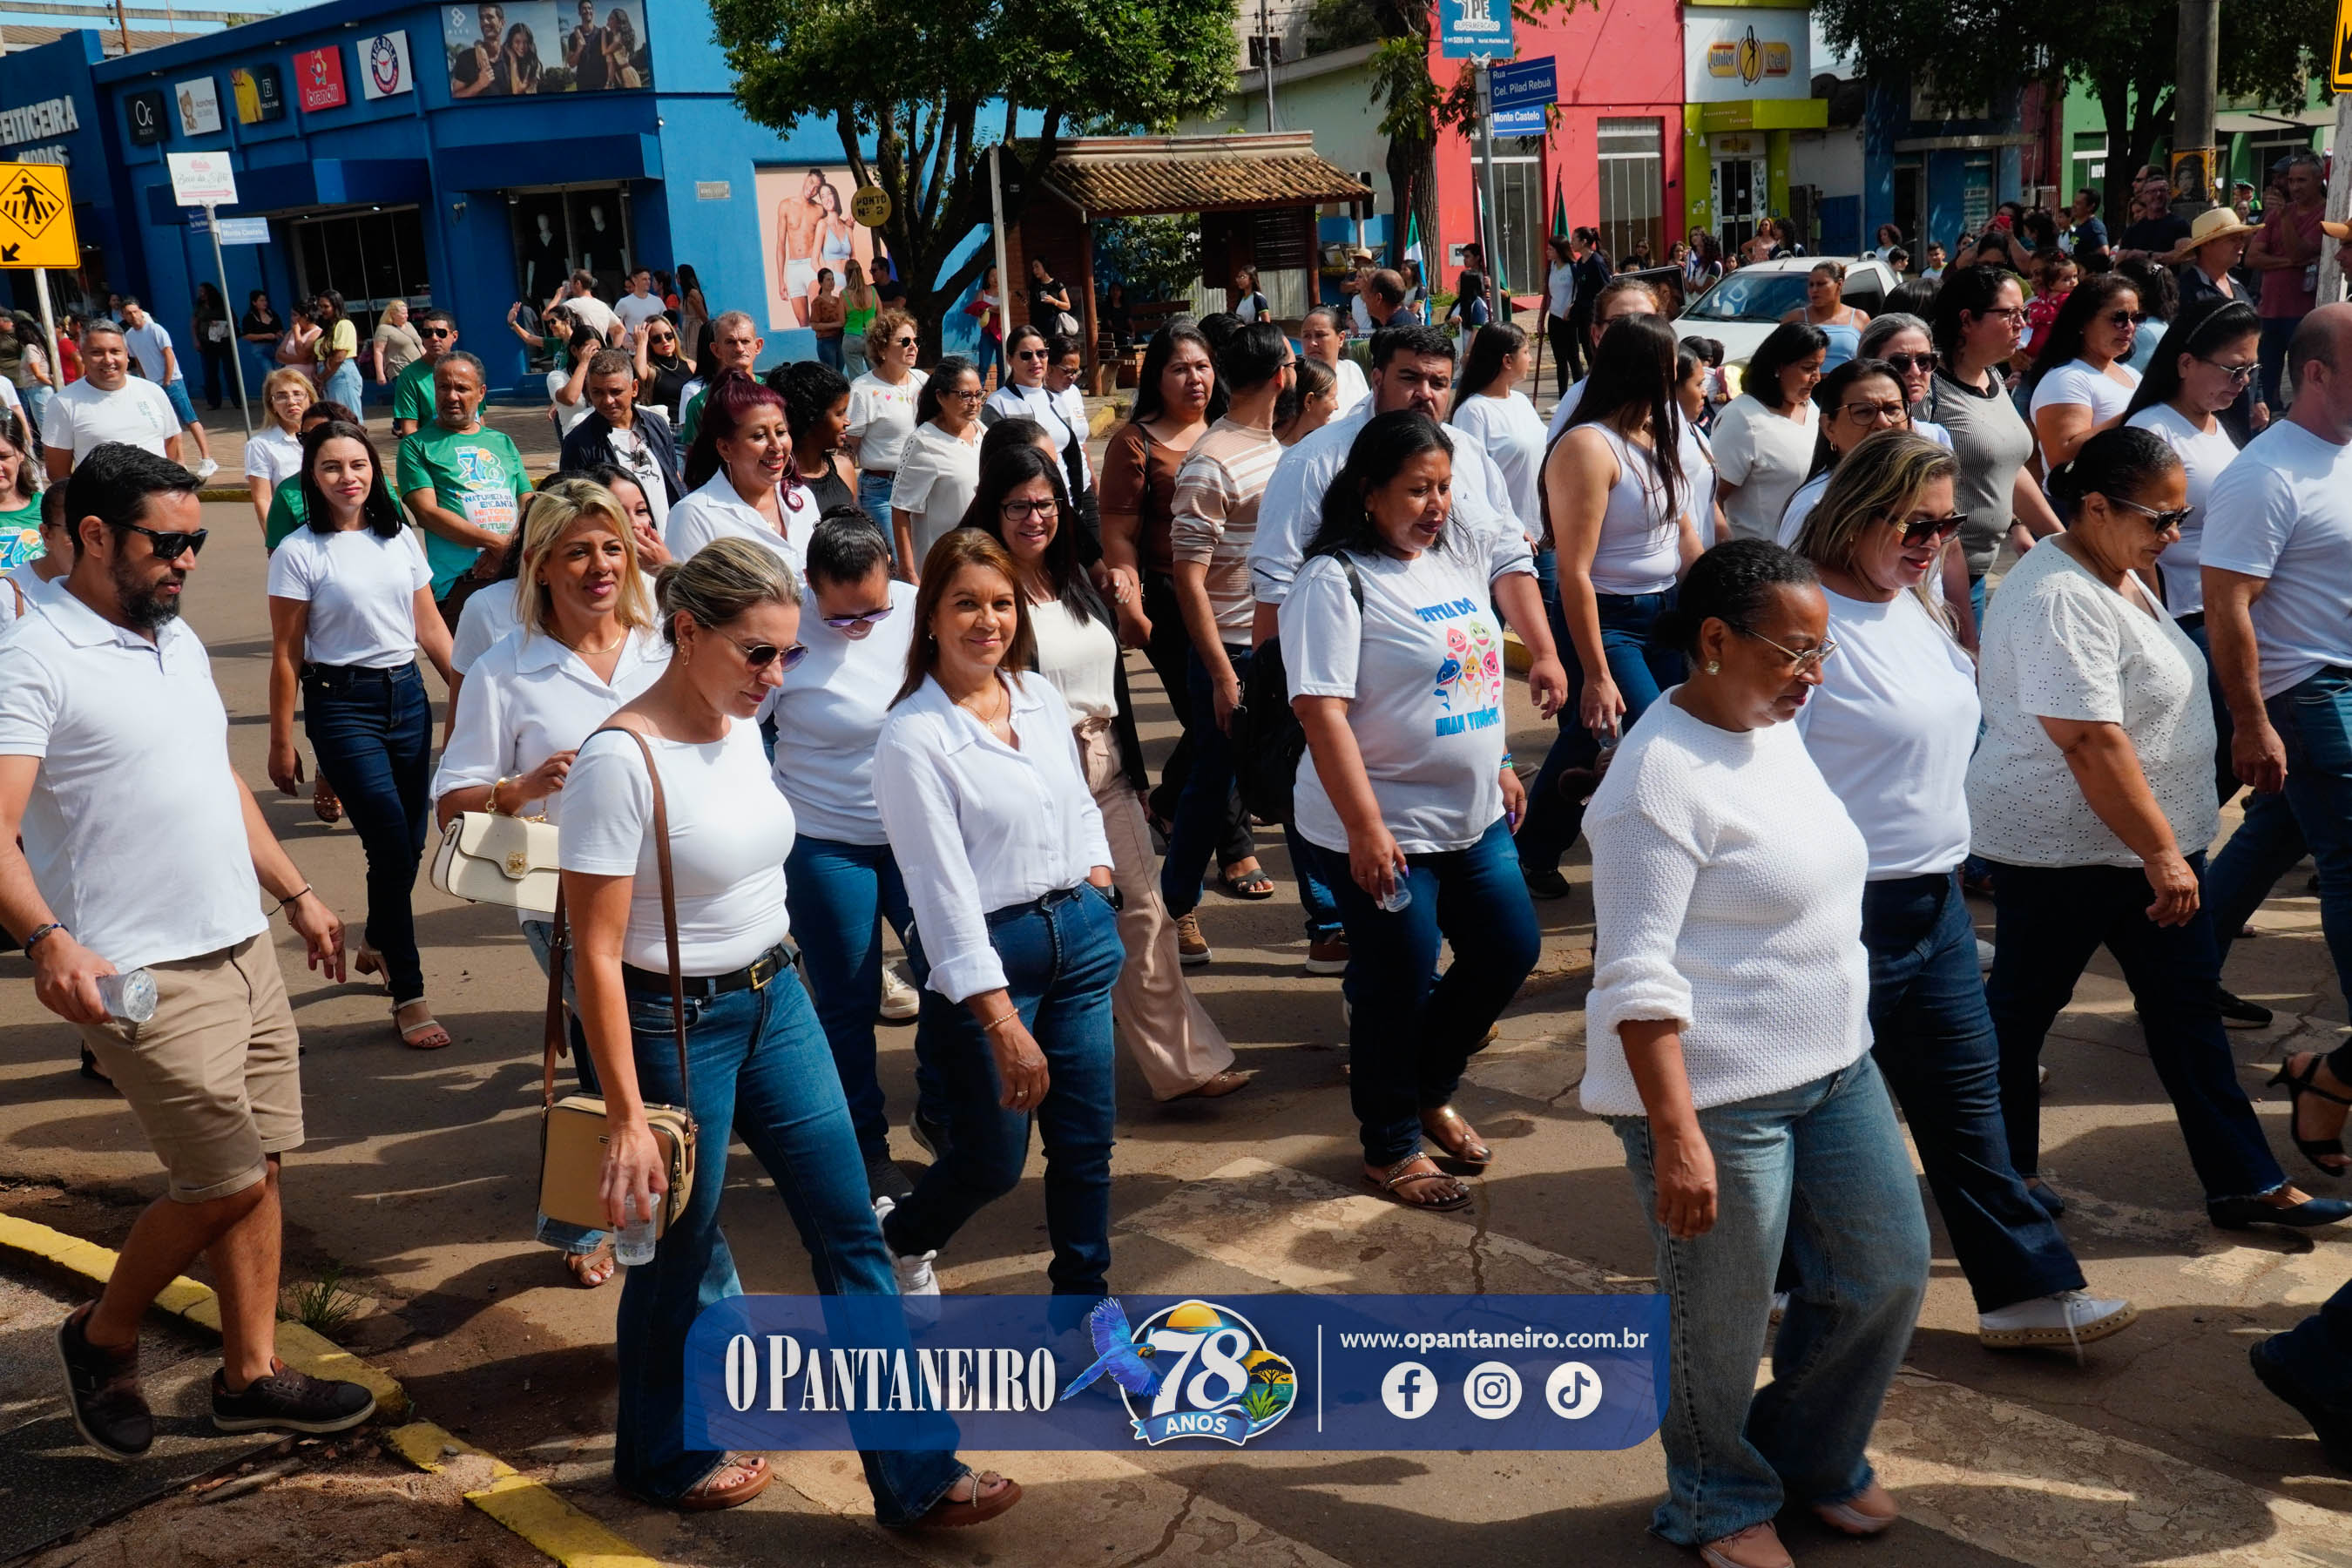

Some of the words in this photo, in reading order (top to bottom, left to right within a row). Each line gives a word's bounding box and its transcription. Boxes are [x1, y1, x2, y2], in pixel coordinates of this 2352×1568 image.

[1708, 52, 1734, 69] Junior
[1768, 52, 1786, 67] Cell
[1492, 71, 1505, 79] Rua
[1494, 85, 1508, 97] Cel.
[1510, 81, 1527, 94] Pilad
[1529, 77, 1551, 91] Rebuá
[1494, 112, 1514, 122] Monte
[1515, 111, 1540, 121] Castelo
[857, 194, 886, 206] PONTO
[876, 206, 883, 215] 2
[1452, 597, 1478, 615] DO
